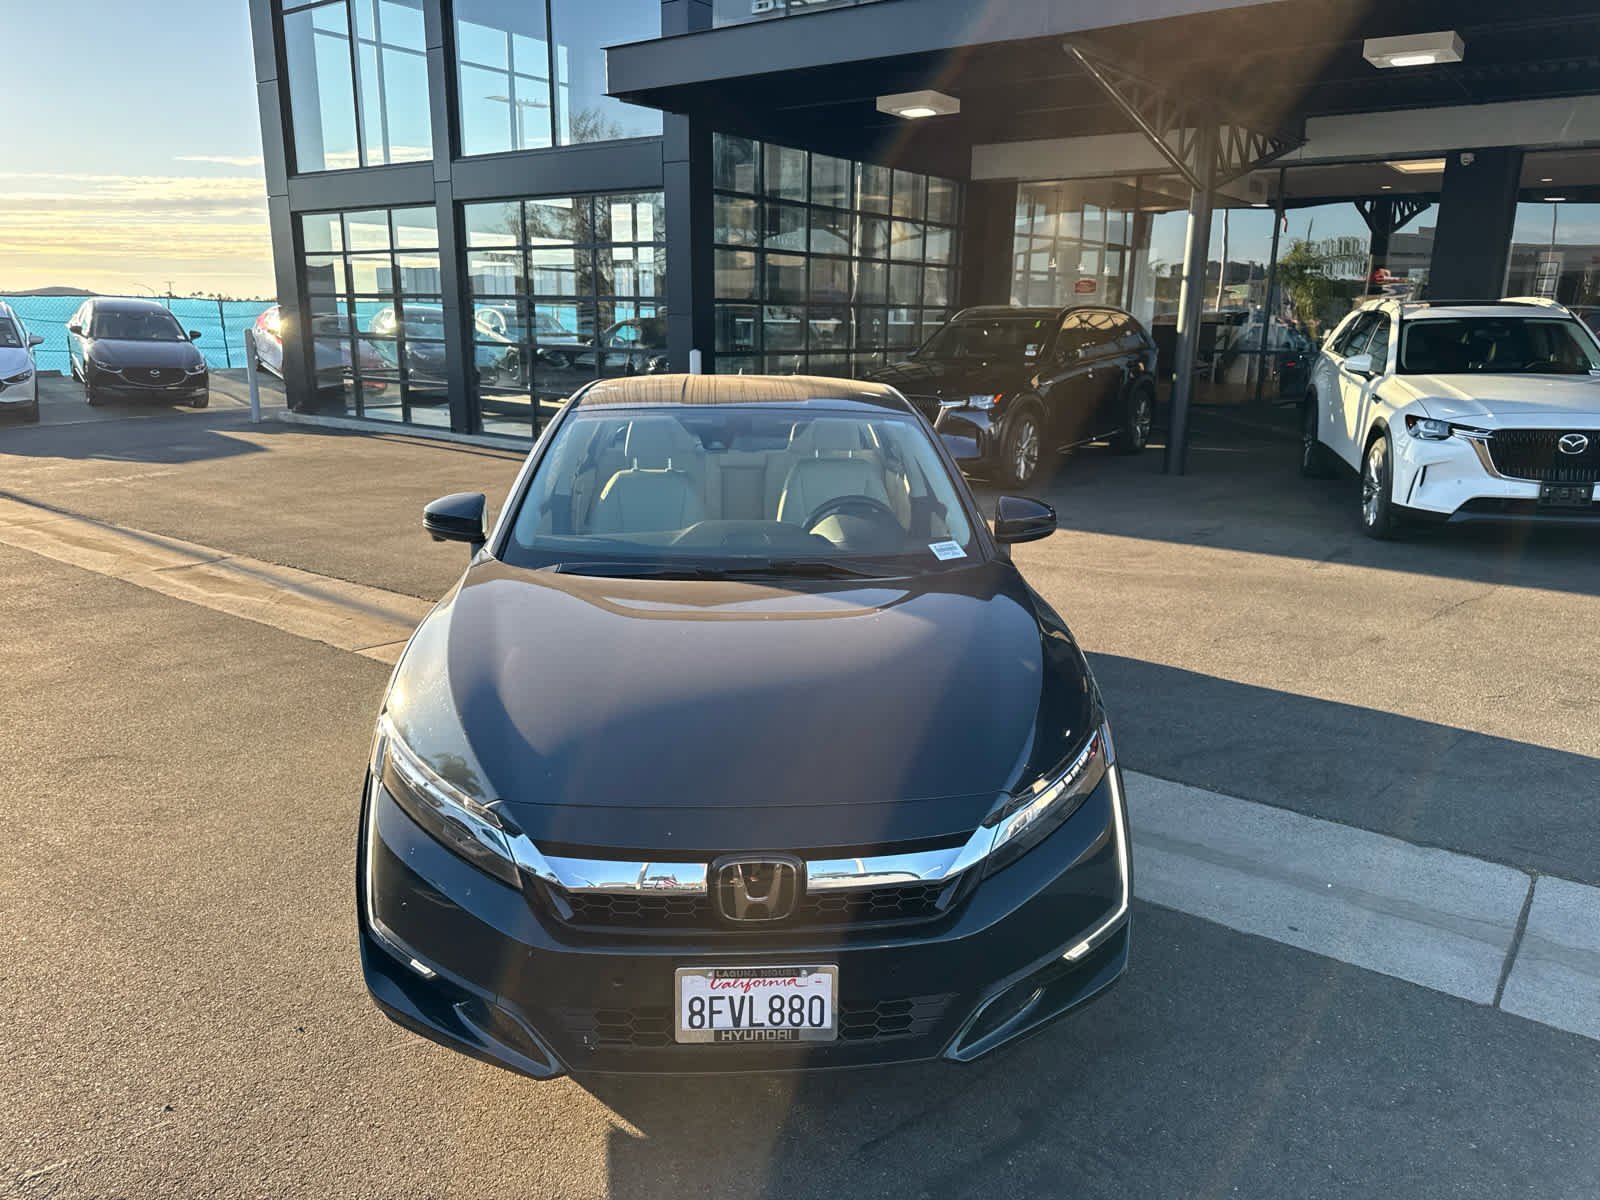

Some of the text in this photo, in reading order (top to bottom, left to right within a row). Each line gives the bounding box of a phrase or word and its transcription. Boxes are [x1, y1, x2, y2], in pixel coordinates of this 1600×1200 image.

[716, 969, 758, 978] LAGUNA
[710, 977, 808, 993] California
[688, 994, 825, 1029] 8FVL880
[721, 1029, 792, 1041] HYUNDAI
